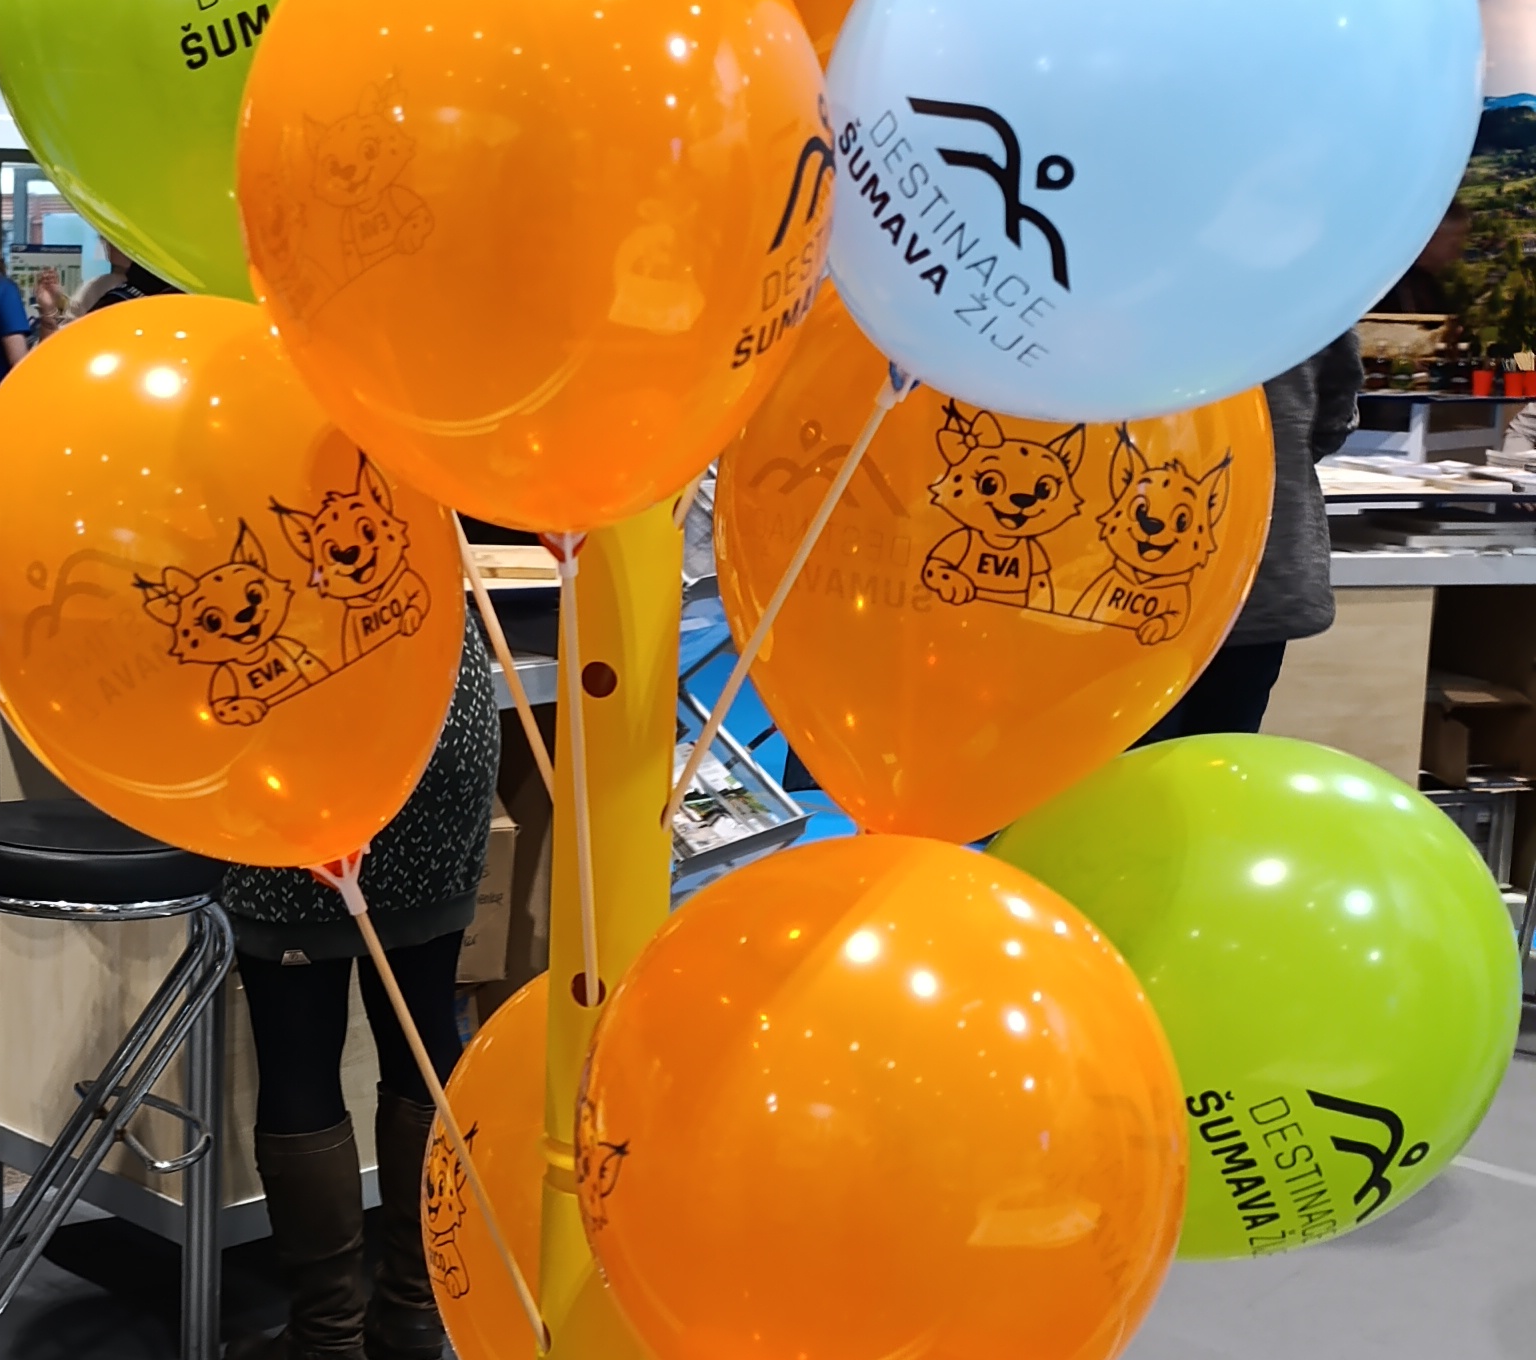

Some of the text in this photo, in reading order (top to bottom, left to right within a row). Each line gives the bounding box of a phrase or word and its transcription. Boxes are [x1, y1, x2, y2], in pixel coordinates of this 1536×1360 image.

[837, 116, 1051, 369] ŠUMAVA ŽIJE
[868, 108, 1057, 329] DESTINACE
[761, 228, 821, 313] DES
[976, 553, 1021, 580] EVA
[360, 598, 404, 638] RICO
[1107, 586, 1159, 618] RICO
[246, 657, 287, 691] EVA
[1186, 1090, 1281, 1231] ŠUMAVA
